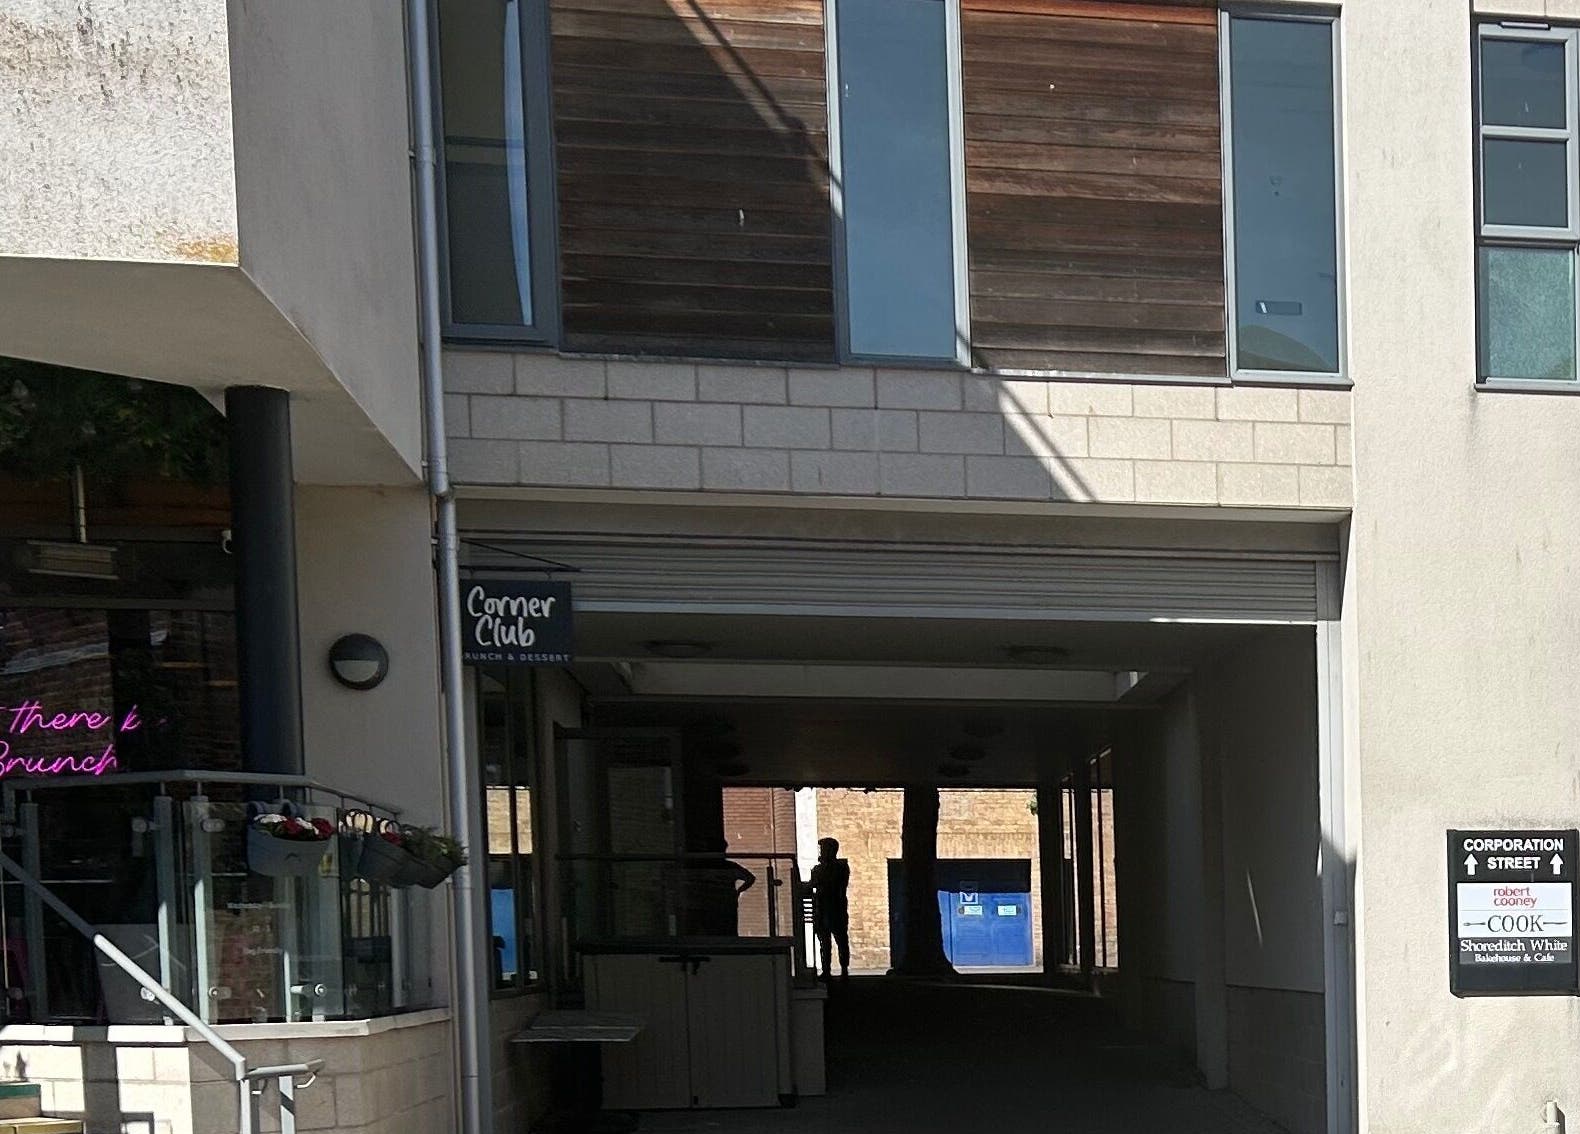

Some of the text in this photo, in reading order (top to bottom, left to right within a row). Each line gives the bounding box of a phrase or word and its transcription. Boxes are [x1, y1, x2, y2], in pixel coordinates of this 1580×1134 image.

[467, 585, 556, 618] Corner
[475, 614, 535, 647] Club
[464, 652, 503, 661] RUNCH
[519, 653, 569, 662] DESSERT
[9, 701, 112, 733] there
[1463, 838, 1564, 852] CORPORATION
[1487, 857, 1541, 870] STREET
[1493, 886, 1531, 897] robert
[1494, 896, 1538, 909] cooney
[1487, 915, 1544, 933] COOK
[1460, 939, 1568, 952] Shoreditch White
[1475, 953, 1521, 963] Bakehouse
[1523, 953, 1532, 962] &
